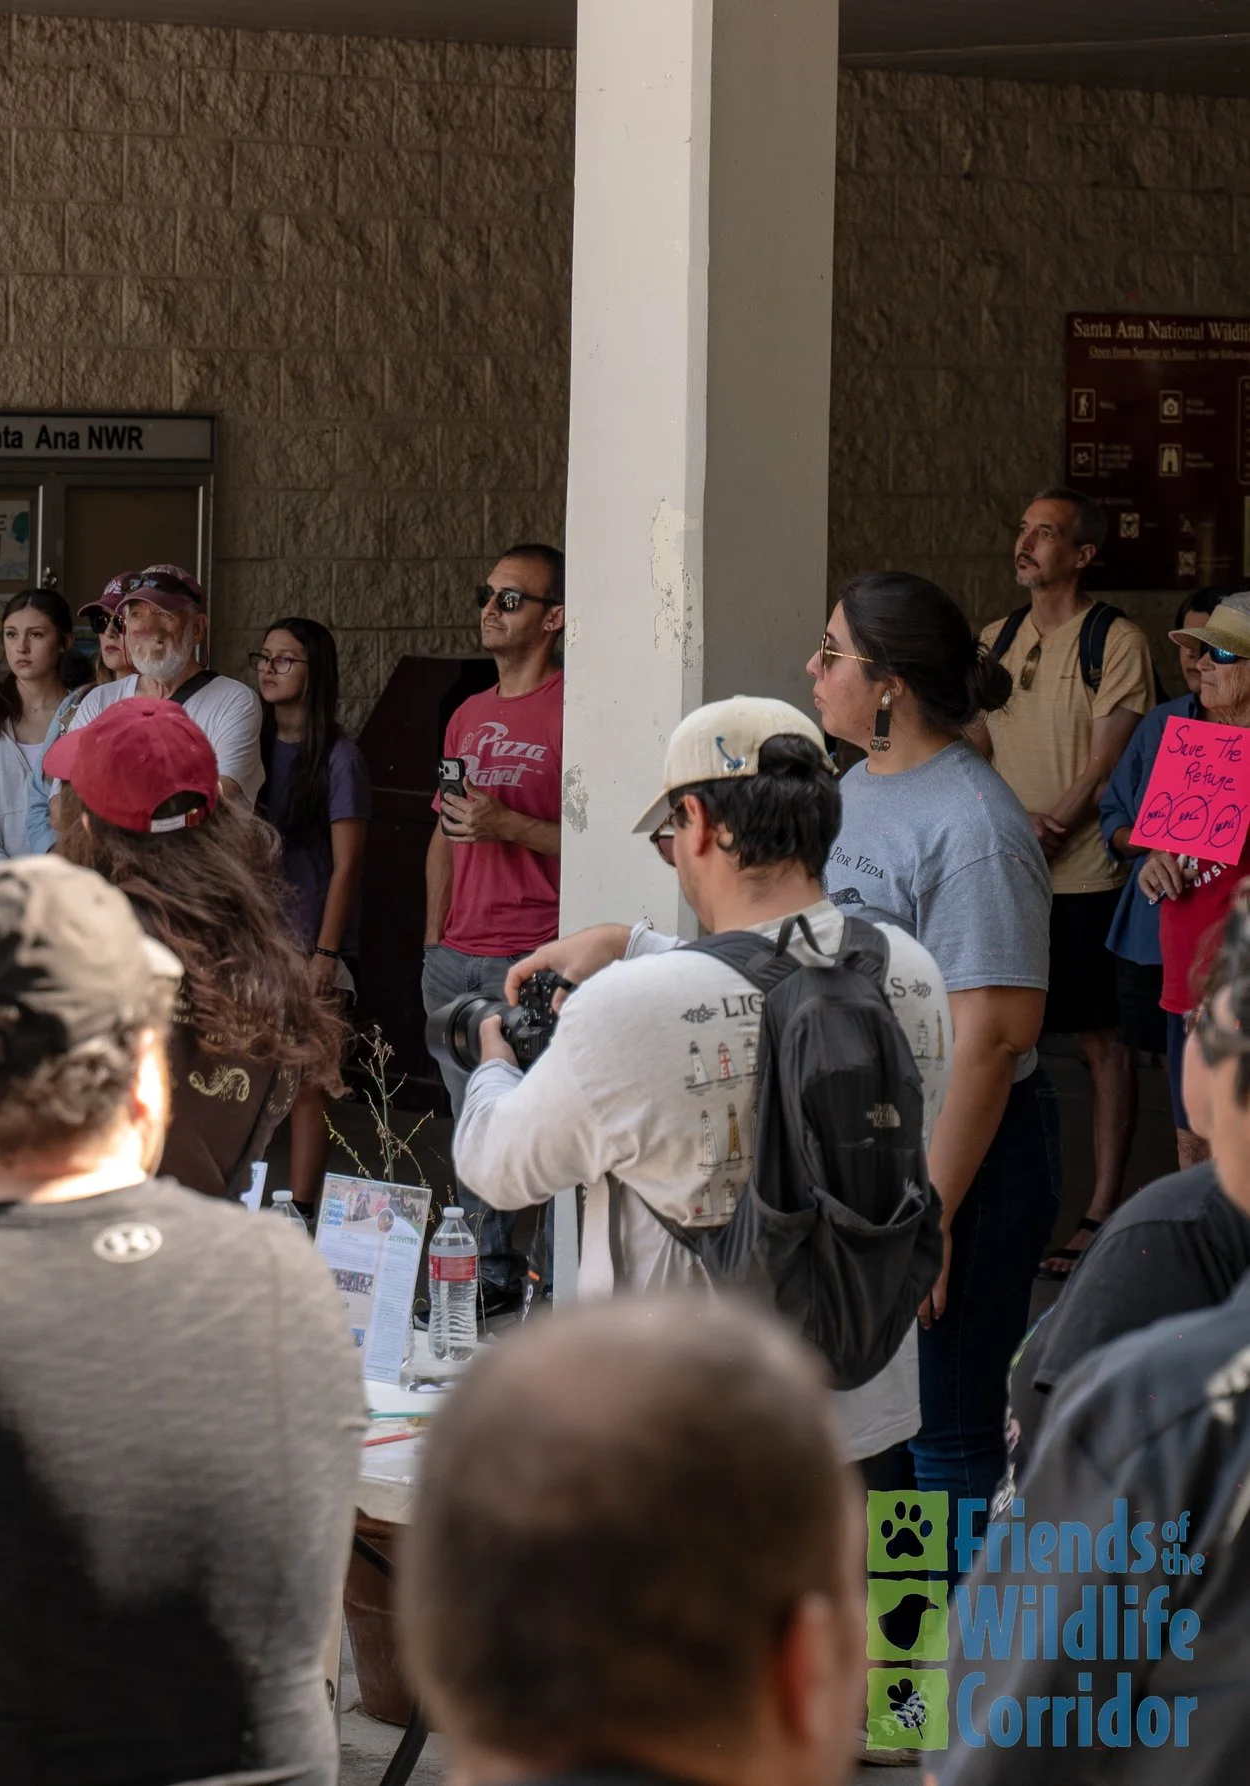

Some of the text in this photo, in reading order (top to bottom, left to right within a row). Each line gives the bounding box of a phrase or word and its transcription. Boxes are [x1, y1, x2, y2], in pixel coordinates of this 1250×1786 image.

[1073, 318, 1112, 338] Santa
[1115, 320, 1145, 340] Ana
[1148, 320, 1205, 341] National
[35, 425, 80, 450] Ana
[88, 425, 144, 451] NWR
[478, 721, 548, 762] Pizza
[1168, 724, 1243, 762] Save The
[1183, 761, 1236, 797] Refuge
